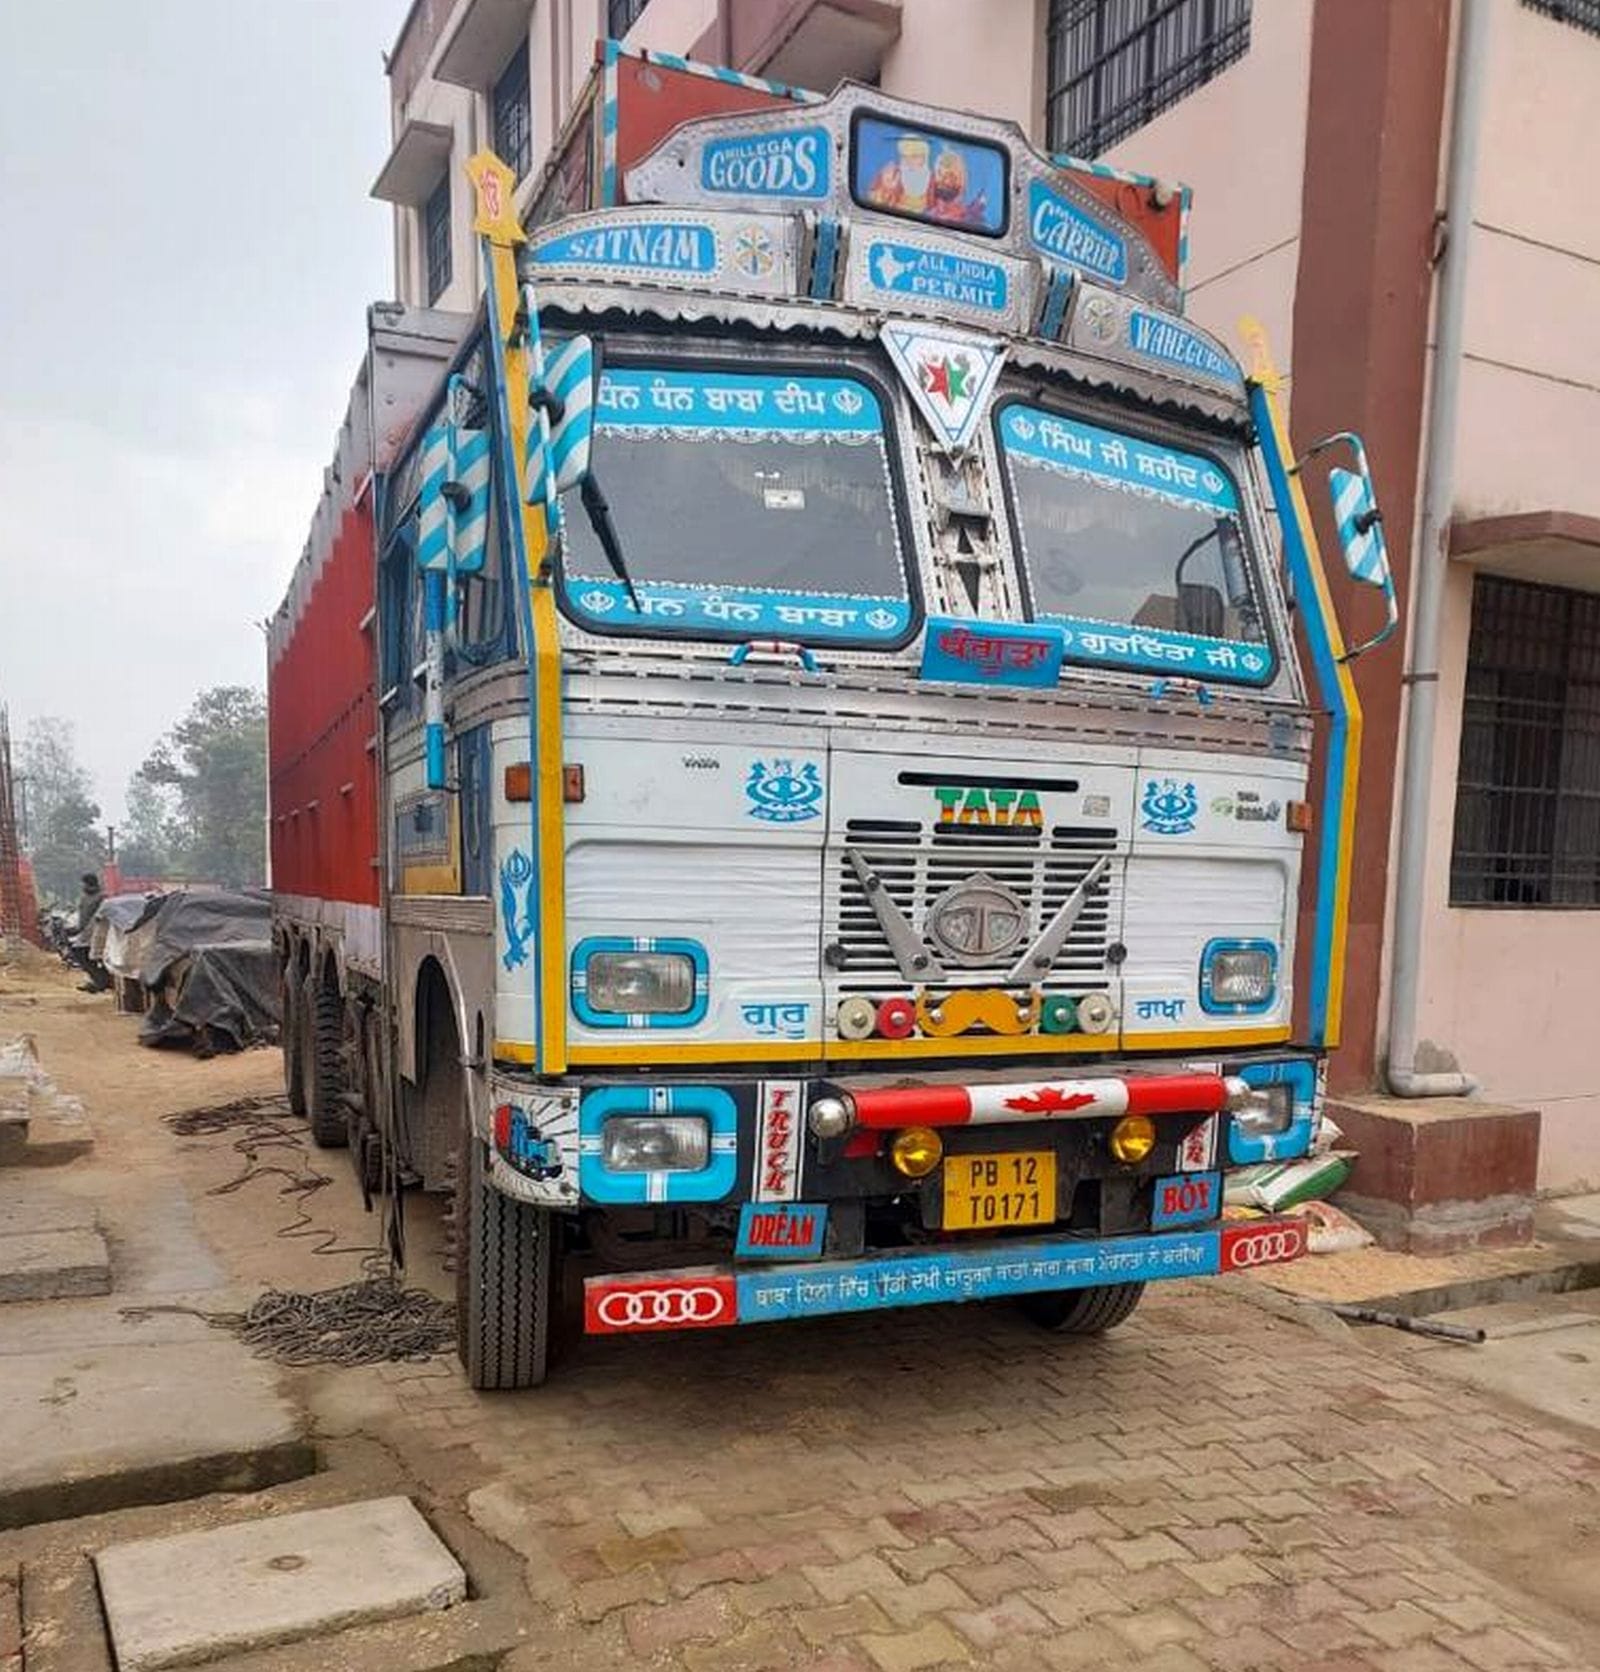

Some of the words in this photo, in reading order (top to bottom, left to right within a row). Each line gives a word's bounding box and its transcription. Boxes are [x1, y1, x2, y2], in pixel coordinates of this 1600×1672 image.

[710, 136, 816, 191] GOODS
[566, 227, 700, 267] SATNAM
[1034, 200, 1118, 276] CARRIER
[918, 254, 949, 273] ALL
[955, 260, 996, 283] INDIA
[912, 276, 996, 306] PERMIT
[649, 378, 694, 412] ਧੰਨ
[703, 387, 763, 413] ਬਾਬਾ
[774, 381, 826, 414] ਦੀਪ
[1100, 441, 1129, 471] ਜੀ
[702, 592, 763, 621] ਧੰਨ
[774, 604, 858, 628] ਬਾਬਾ
[1206, 642, 1237, 669] ਜੀ
[935, 788, 1043, 826] TATA
[1134, 998, 1186, 1022] ਰਾਖਾ
[764, 1089, 793, 1193] TRUCK
[971, 1160, 998, 1188] PB
[1012, 1157, 1037, 1184] 12
[1163, 1181, 1211, 1215] BOY
[750, 1212, 814, 1246] DREAM
